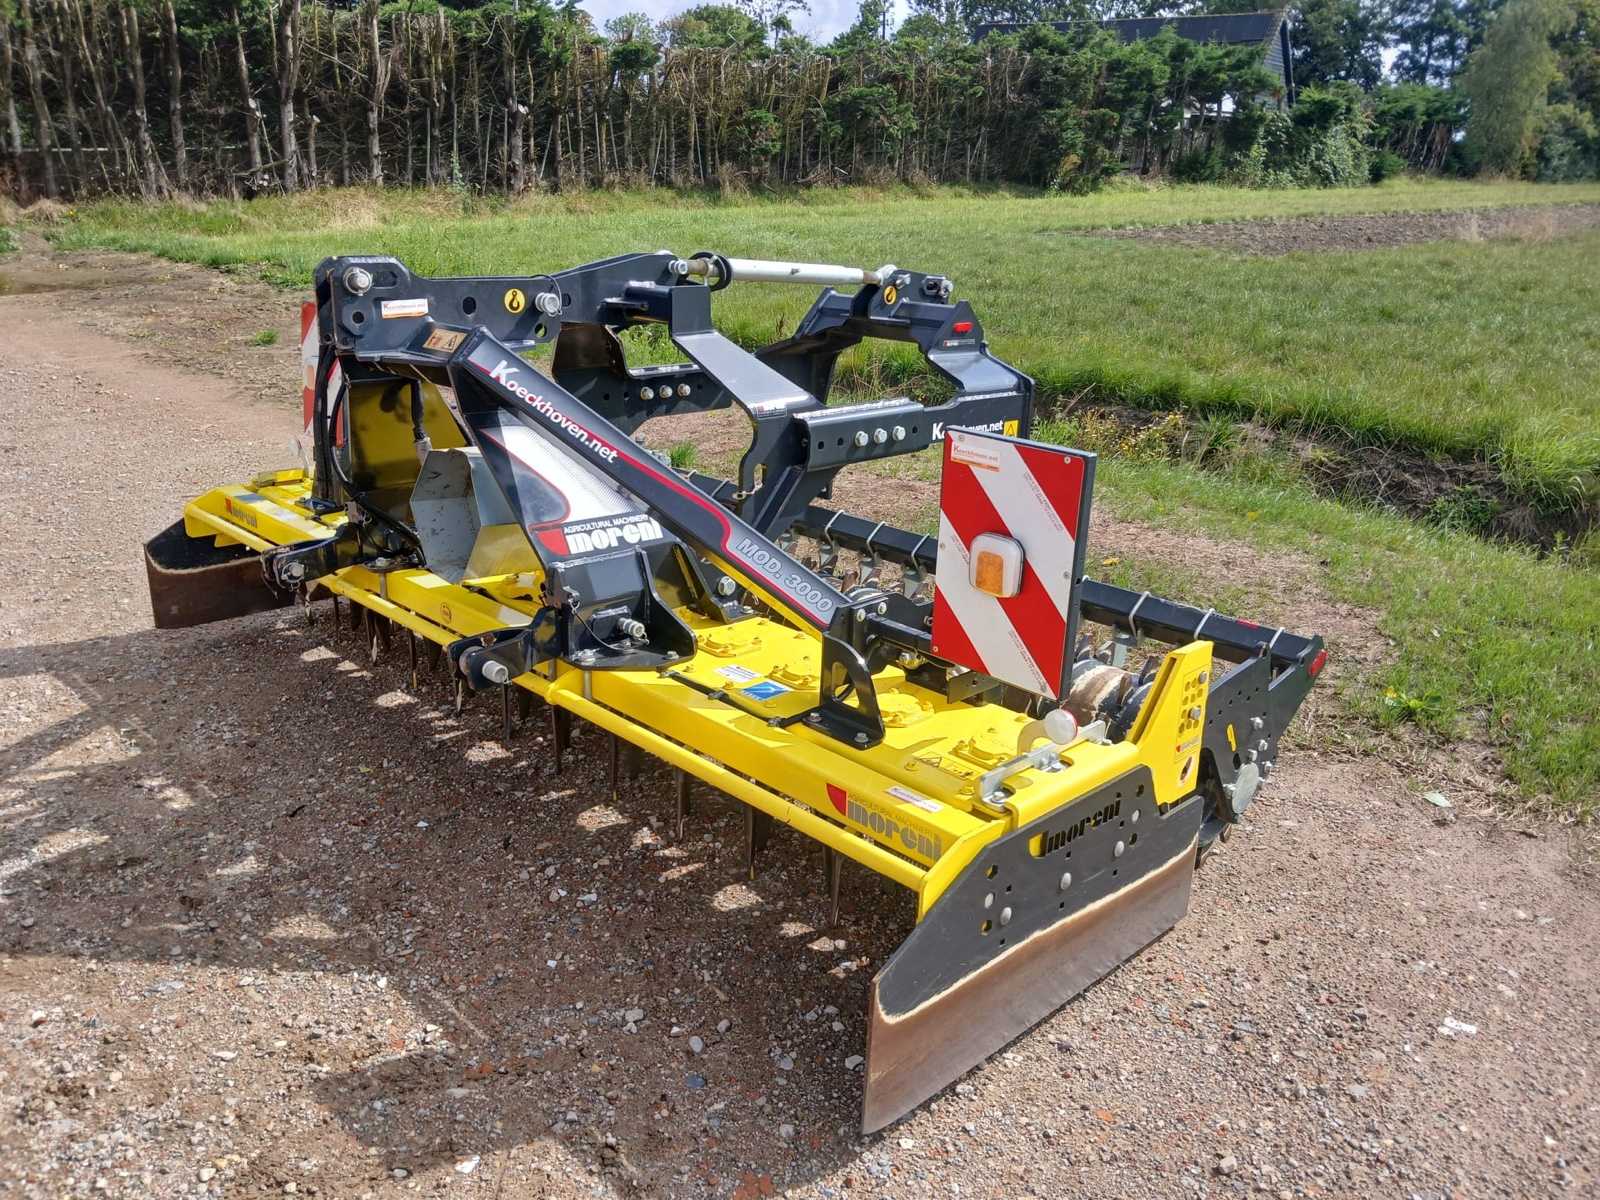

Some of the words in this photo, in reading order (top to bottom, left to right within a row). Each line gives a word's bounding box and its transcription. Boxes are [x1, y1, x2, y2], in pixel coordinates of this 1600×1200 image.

[489, 360, 618, 463] Koeckhoven.net
[564, 520, 613, 534] AGRICULTURAL
[565, 516, 663, 554] moreni
[736, 538, 783, 579] MOD.
[784, 574, 833, 612] 3000
[848, 800, 943, 862] moreni
[1048, 792, 1121, 853] moreni
